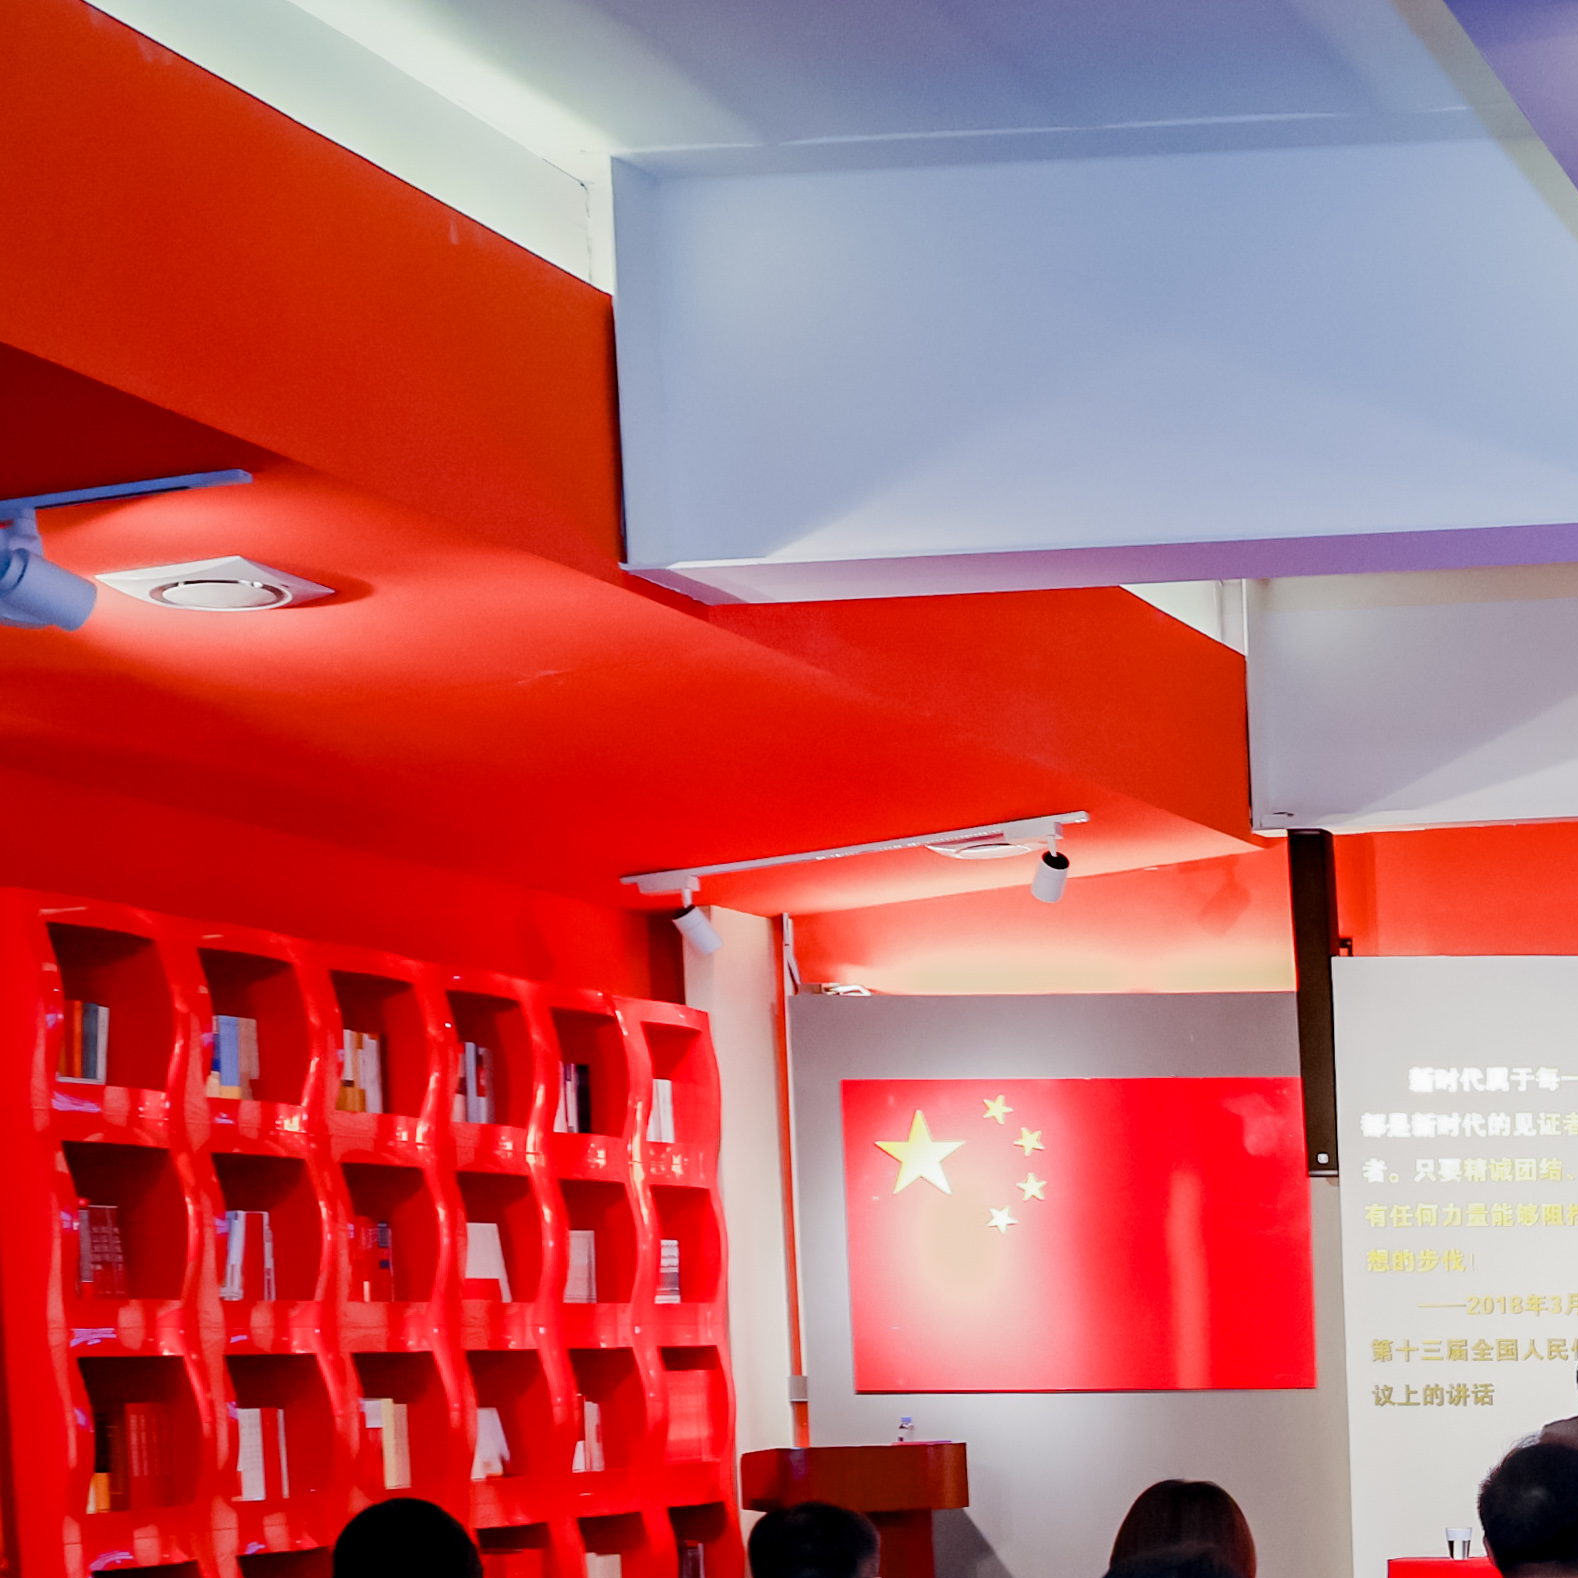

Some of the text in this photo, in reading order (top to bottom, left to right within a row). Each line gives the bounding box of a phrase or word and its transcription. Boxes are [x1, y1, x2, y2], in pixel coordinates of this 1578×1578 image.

[1371, 1383, 1495, 1408] 议上的讲话
